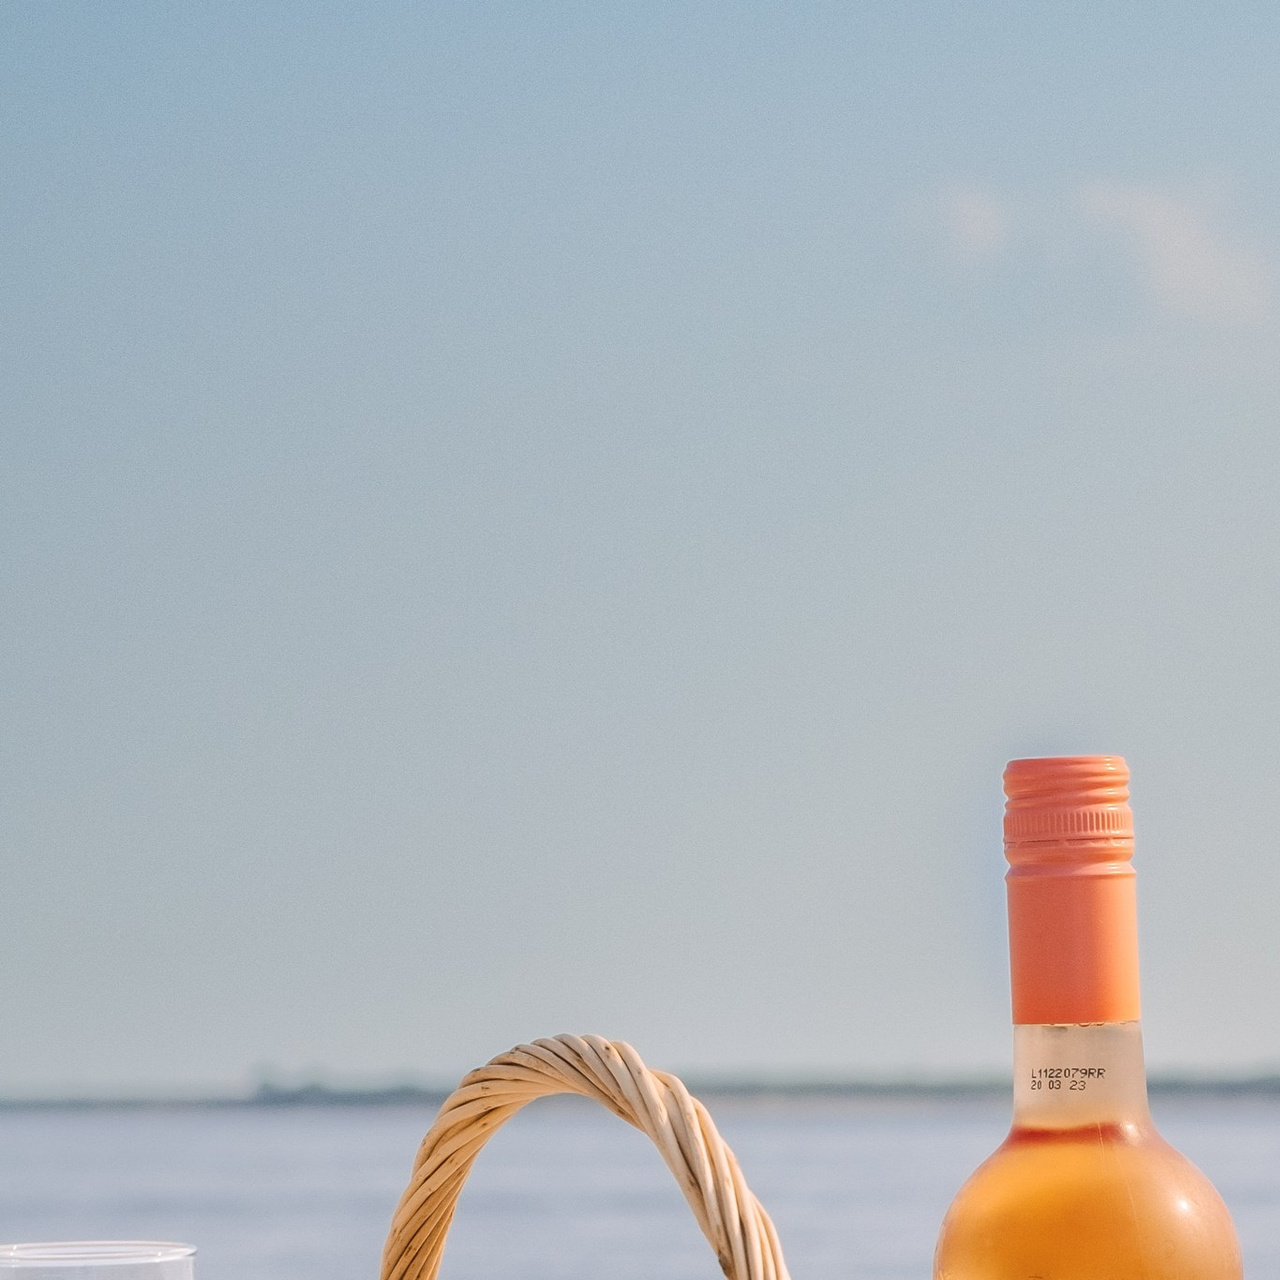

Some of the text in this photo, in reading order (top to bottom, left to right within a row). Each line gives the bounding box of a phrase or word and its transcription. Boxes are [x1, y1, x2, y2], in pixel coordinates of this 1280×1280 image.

[1031, 1067, 1106, 1079] L1122079RR
[1030, 1079, 1087, 1091] 20 03 23
